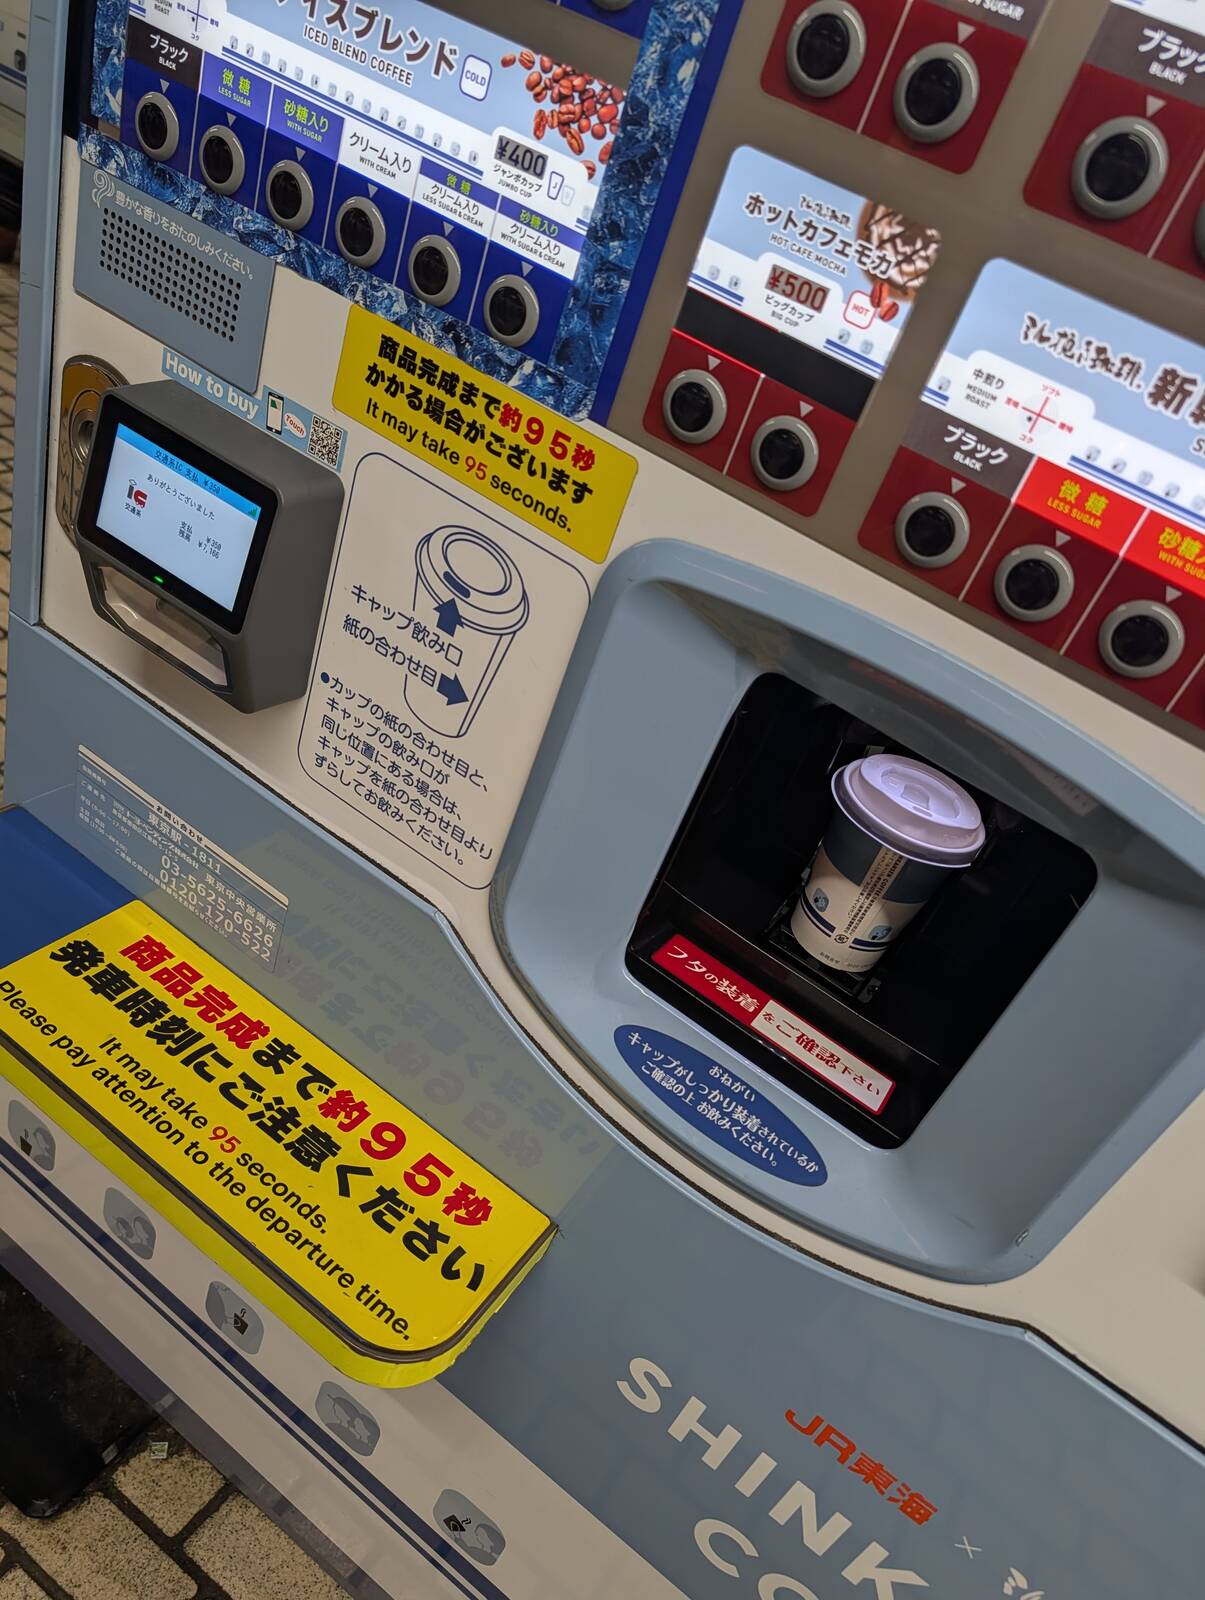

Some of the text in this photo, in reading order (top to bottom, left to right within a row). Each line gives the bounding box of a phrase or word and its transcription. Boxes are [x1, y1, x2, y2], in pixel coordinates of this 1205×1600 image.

[150, 33, 188, 62] ブラック
[158, 56, 177, 71] BLACK
[303, 24, 413, 86] ICED BLEND COFFEE
[464, 69, 487, 87] COLD
[1149, 61, 1187, 85] BLACK
[218, 86, 252, 107] LESS SUGAR
[283, 98, 329, 132] 砂糖入り
[286, 119, 323, 143] WITH SUGAR
[349, 131, 412, 174] クリーム入り
[359, 155, 397, 180] WITH CREAM
[496, 138, 547, 179] ¥400
[493, 163, 543, 193] ジャンボカップ
[498, 180, 532, 199] JUMBO CUP
[422, 193, 437, 207] LESS
[437, 200, 458, 218] SUGAR
[462, 212, 484, 229] CREAM
[431, 183, 480, 216] クリーム入り
[115, 190, 254, 280] 豊かな香りをおたのしみください。
[510, 223, 561, 256] クリーム入り
[519, 209, 559, 238] 砂糖入り
[746, 194, 892, 278] ホットカフェモカ
[500, 231, 517, 245] WITH
[517, 240, 538, 257] SUGAR
[543, 253, 565, 269] CREAM
[769, 233, 847, 276] HOT CAFE MOCHA
[764, 293, 814, 324] ビッグカップ
[768, 267, 828, 313] ¥500
[770, 310, 800, 329] BIG CUP
[852, 303, 869, 317] HOT
[165, 352, 259, 420] How to buy
[965, 393, 991, 409] ROAST
[966, 383, 997, 402] MEDIUM
[286, 414, 305, 436] Touch
[365, 363, 594, 505] かかる場合がございます
[943, 424, 1008, 465] ブラック
[154, 449, 221, 495] 交通系IC 支払 ¥350
[366, 397, 573, 533] It may take 95 seconds.
[953, 451, 983, 472] BLACK
[124, 502, 142, 518] 交通系
[146, 473, 215, 521] ありがとうございました
[1047, 497, 1102, 529] LESS SUGAR
[180, 521, 222, 551] 支払 ¥350
[1158, 549, 1182, 569] WITH
[351, 583, 463, 667] キャップ飲み口
[342, 613, 437, 687] 紙の合わせ目
[326, 696, 450, 785] キャップの飲み口が
[320, 713, 463, 820] 同じ位置にある場合は、
[314, 752, 464, 866] ずらしてお飲みください。
[317, 735, 493, 860] キャップを紙の合わせ目より
[156, 805, 203, 843] お問い合わせ
[160, 870, 271, 962] 0120-170-522
[161, 855, 273, 948] 03-5625-6626
[206, 872, 277, 934] 東京中央営業所
[627, 1032, 820, 1173] キャップがしっかり装着されているか
[708, 1065, 756, 1102] おねがい
[49, 939, 486, 1292] 発車時刻にご注意ください
[641, 1060, 778, 1167] ご確認の上 お飲みください。
[99, 1037, 328, 1235] It may take 95 seconds.
[0, 980, 412, 1340] Please pay attention to the departure time.
[784, 1408, 938, 1526] JR東海
